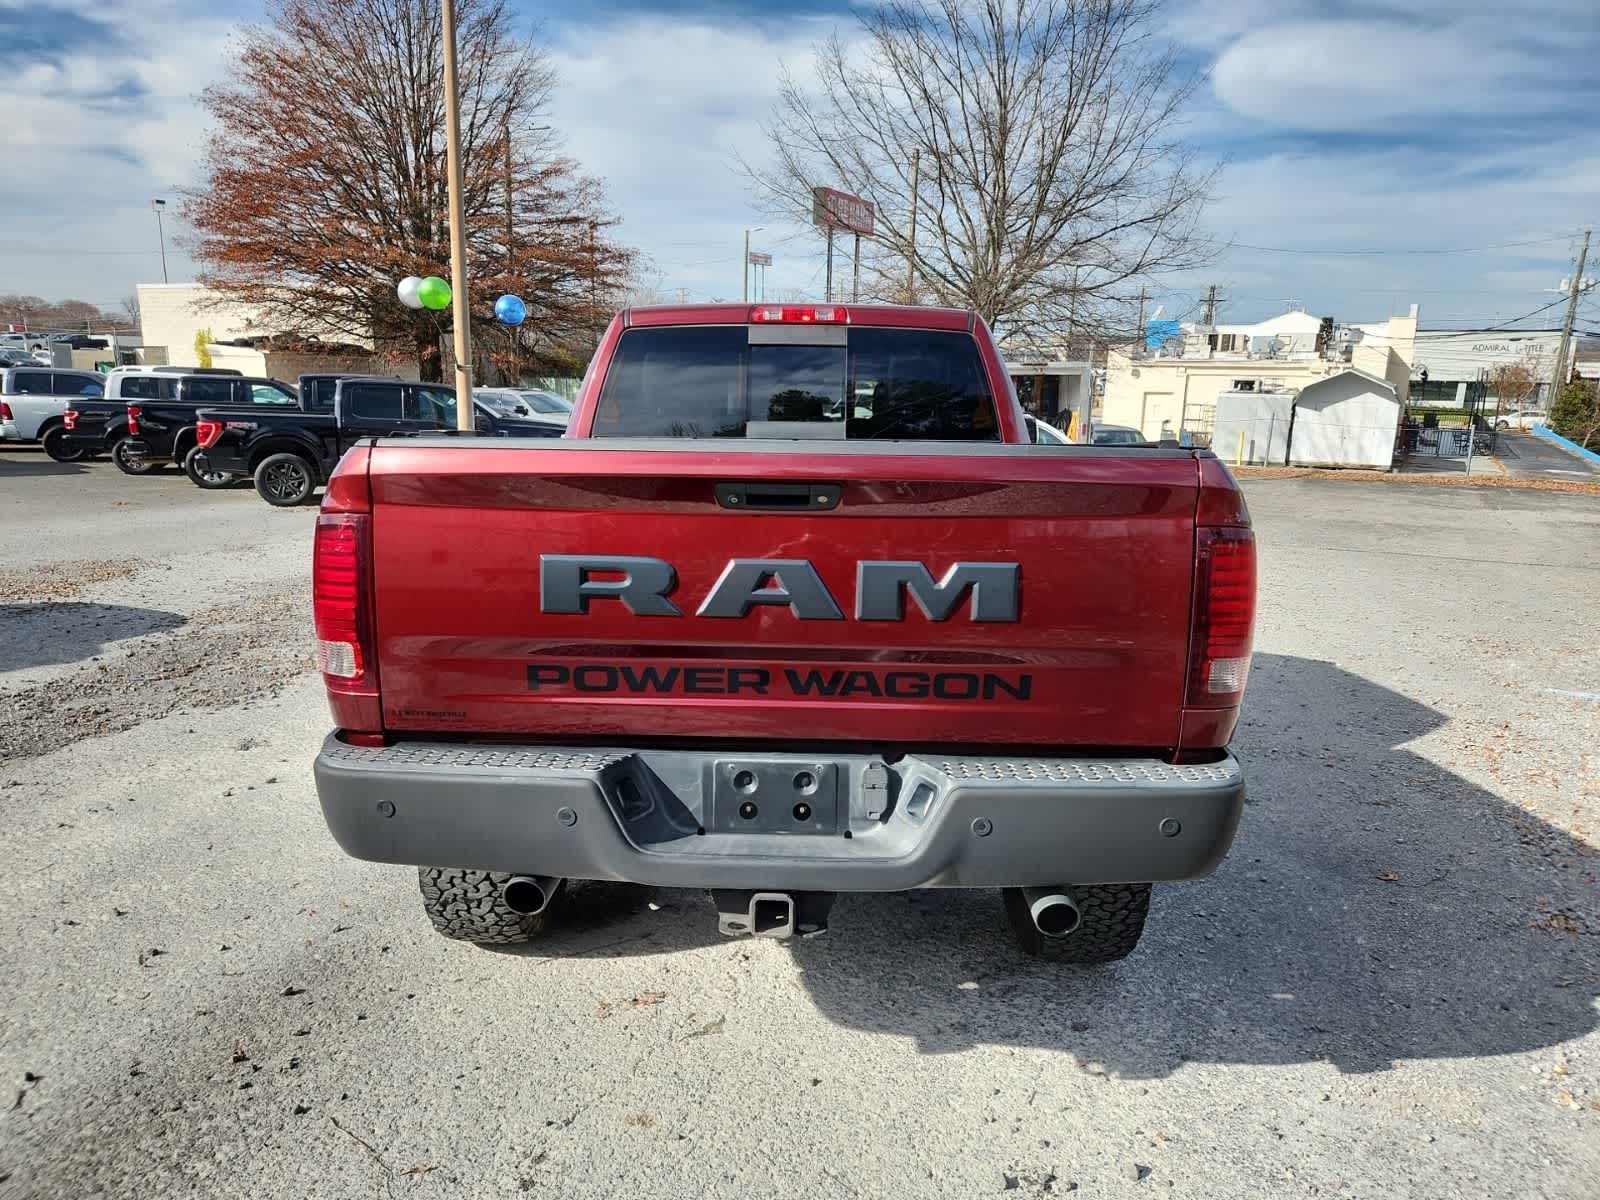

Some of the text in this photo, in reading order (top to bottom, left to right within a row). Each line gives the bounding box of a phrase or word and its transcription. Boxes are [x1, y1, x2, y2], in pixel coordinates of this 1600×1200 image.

[1472, 344, 1510, 352] ADMIRAL
[539, 553, 1022, 622] RAM
[526, 664, 1033, 700] POWER WAGON
